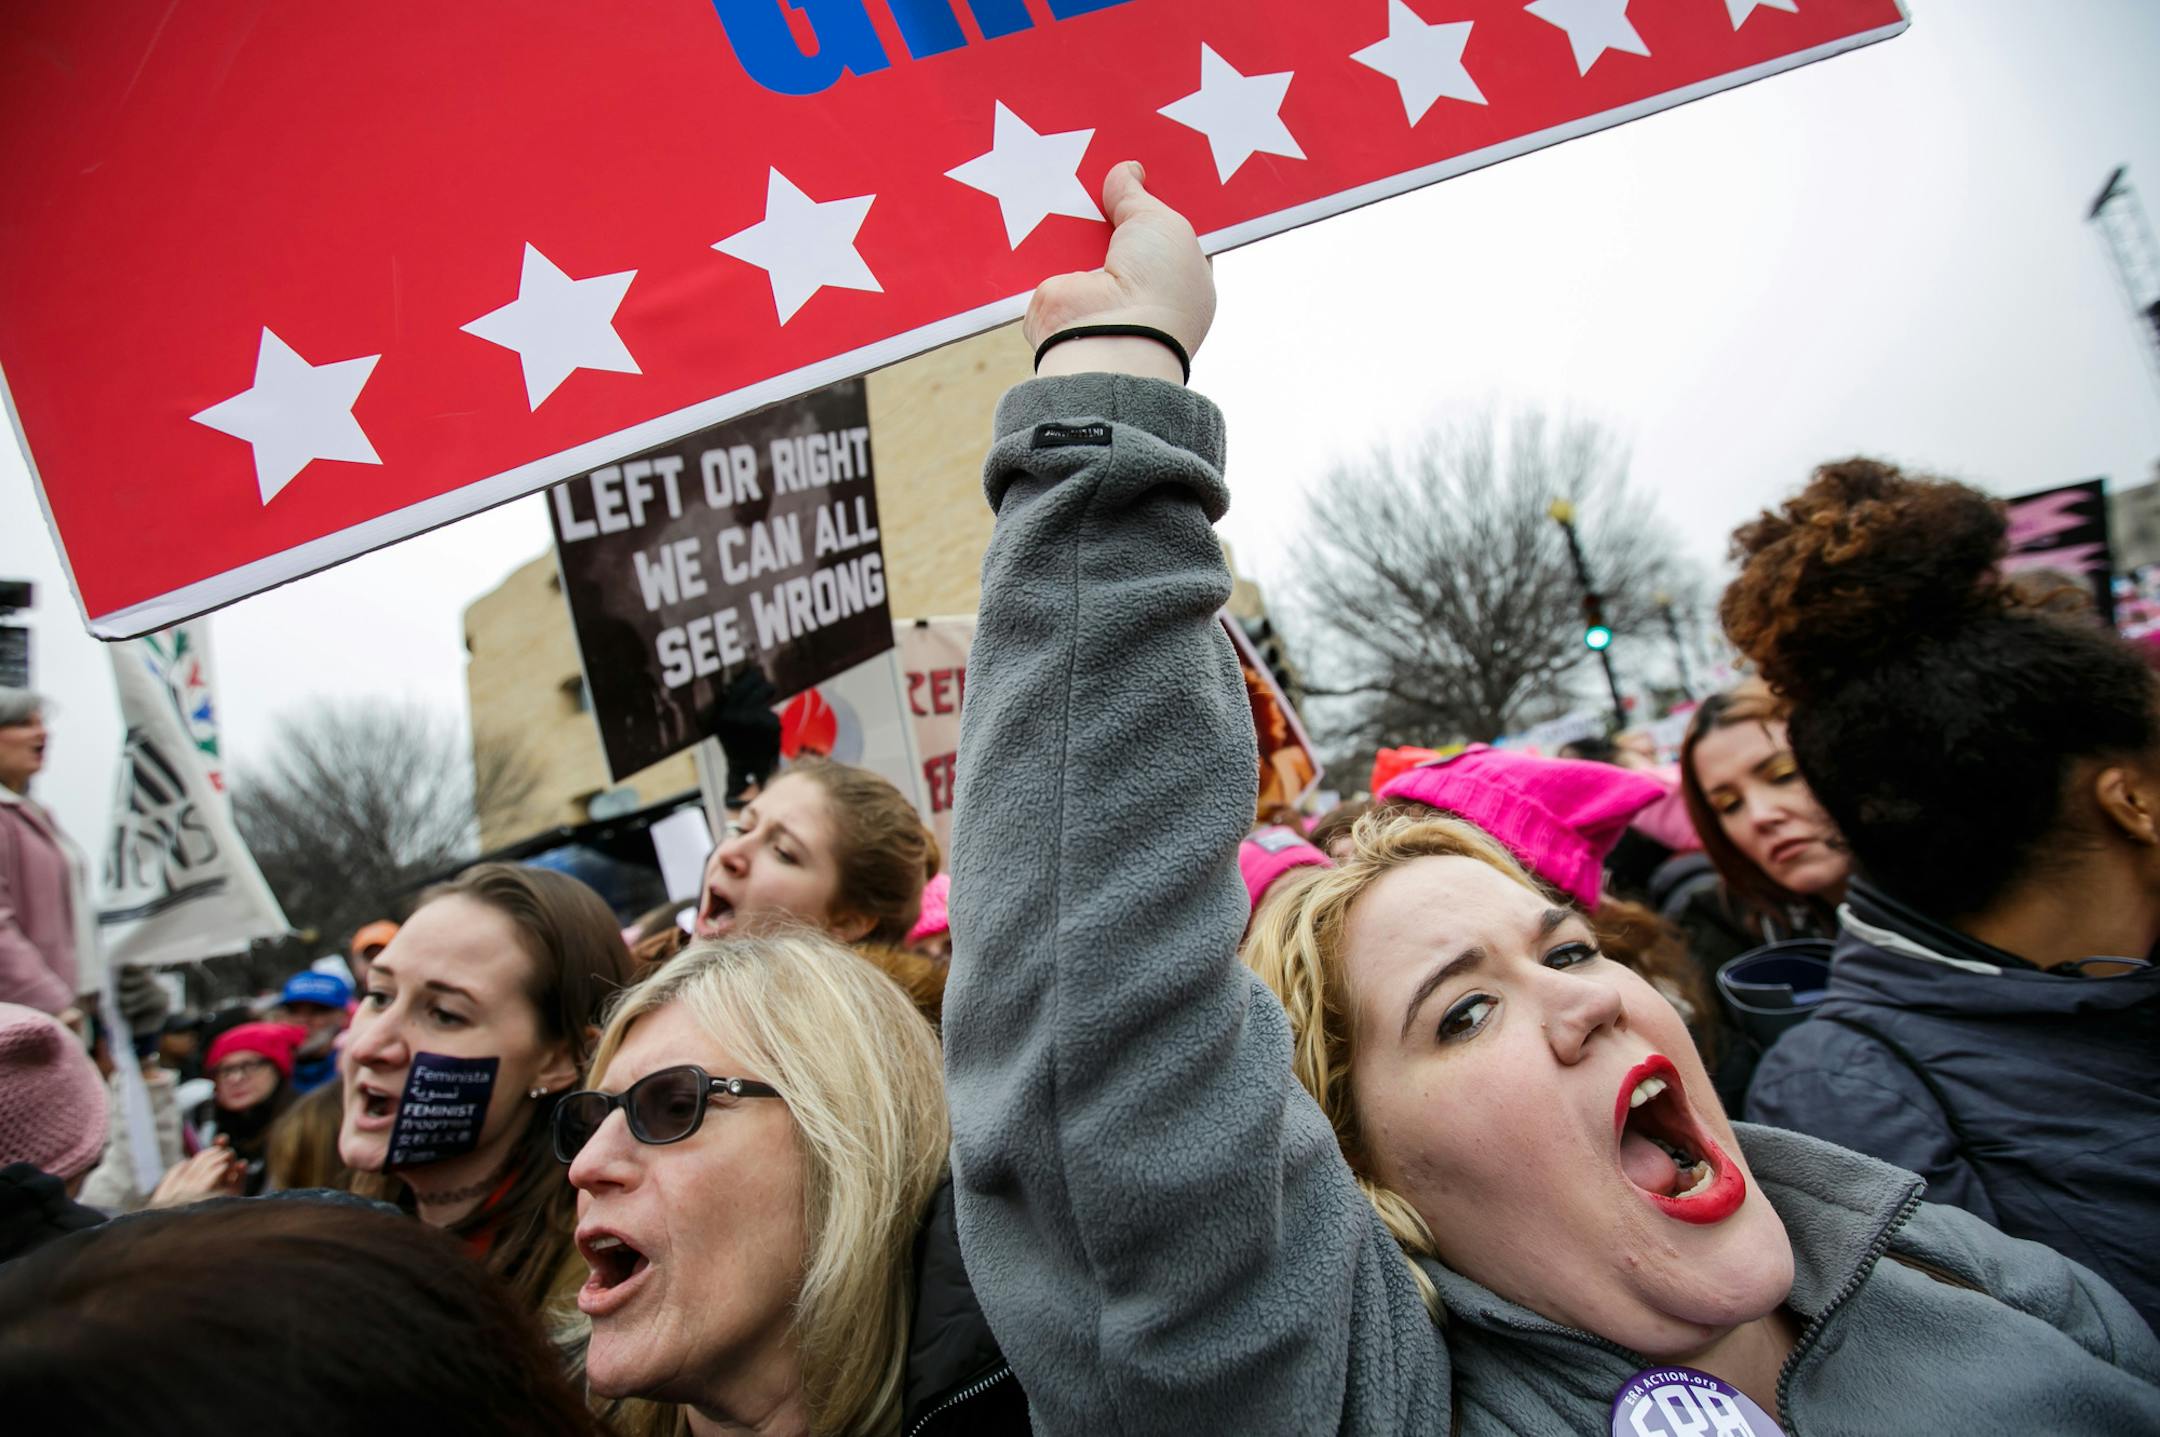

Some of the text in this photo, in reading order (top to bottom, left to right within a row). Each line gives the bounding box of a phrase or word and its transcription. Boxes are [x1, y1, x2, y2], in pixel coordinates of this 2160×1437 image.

[552, 427, 870, 543] LEFT OR RIGHT
[633, 496, 879, 612] WE CAN ALL
[656, 558, 886, 689] SEE WRONG
[402, 1102, 478, 1118] FEMINIST
[413, 1065, 491, 1084] Feminista
[1624, 1371, 1718, 1406] ERA ACTION.org
